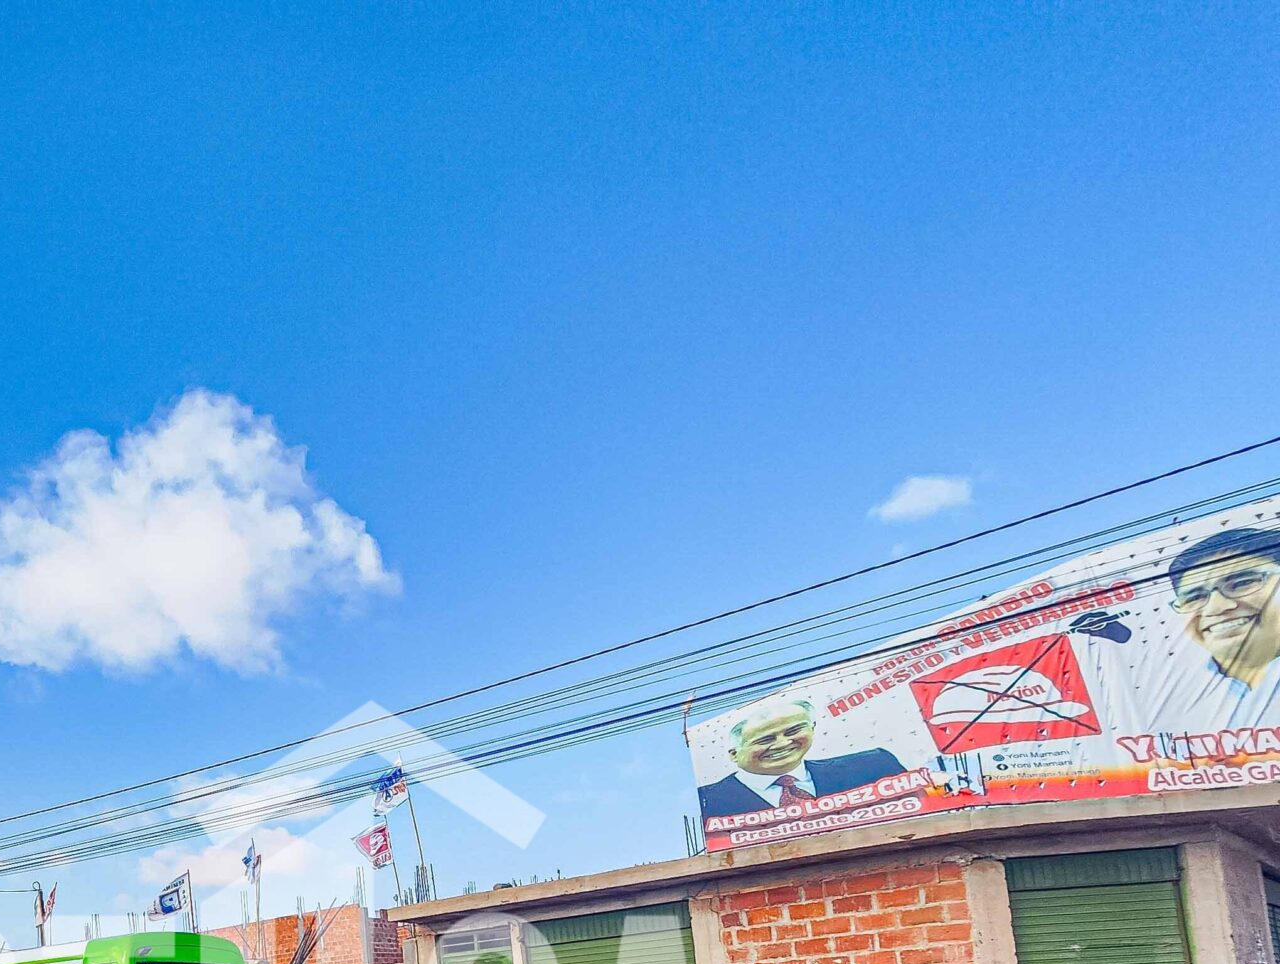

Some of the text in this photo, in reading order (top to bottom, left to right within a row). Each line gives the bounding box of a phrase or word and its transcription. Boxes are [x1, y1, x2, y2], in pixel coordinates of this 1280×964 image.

[827, 652, 945, 717] HONESTO
[1153, 768, 1243, 787] Alcalde
[706, 805, 802, 831] ALFONSO
[805, 785, 876, 814] LOPEZ
[734, 799, 917, 840] Presidente 2026
